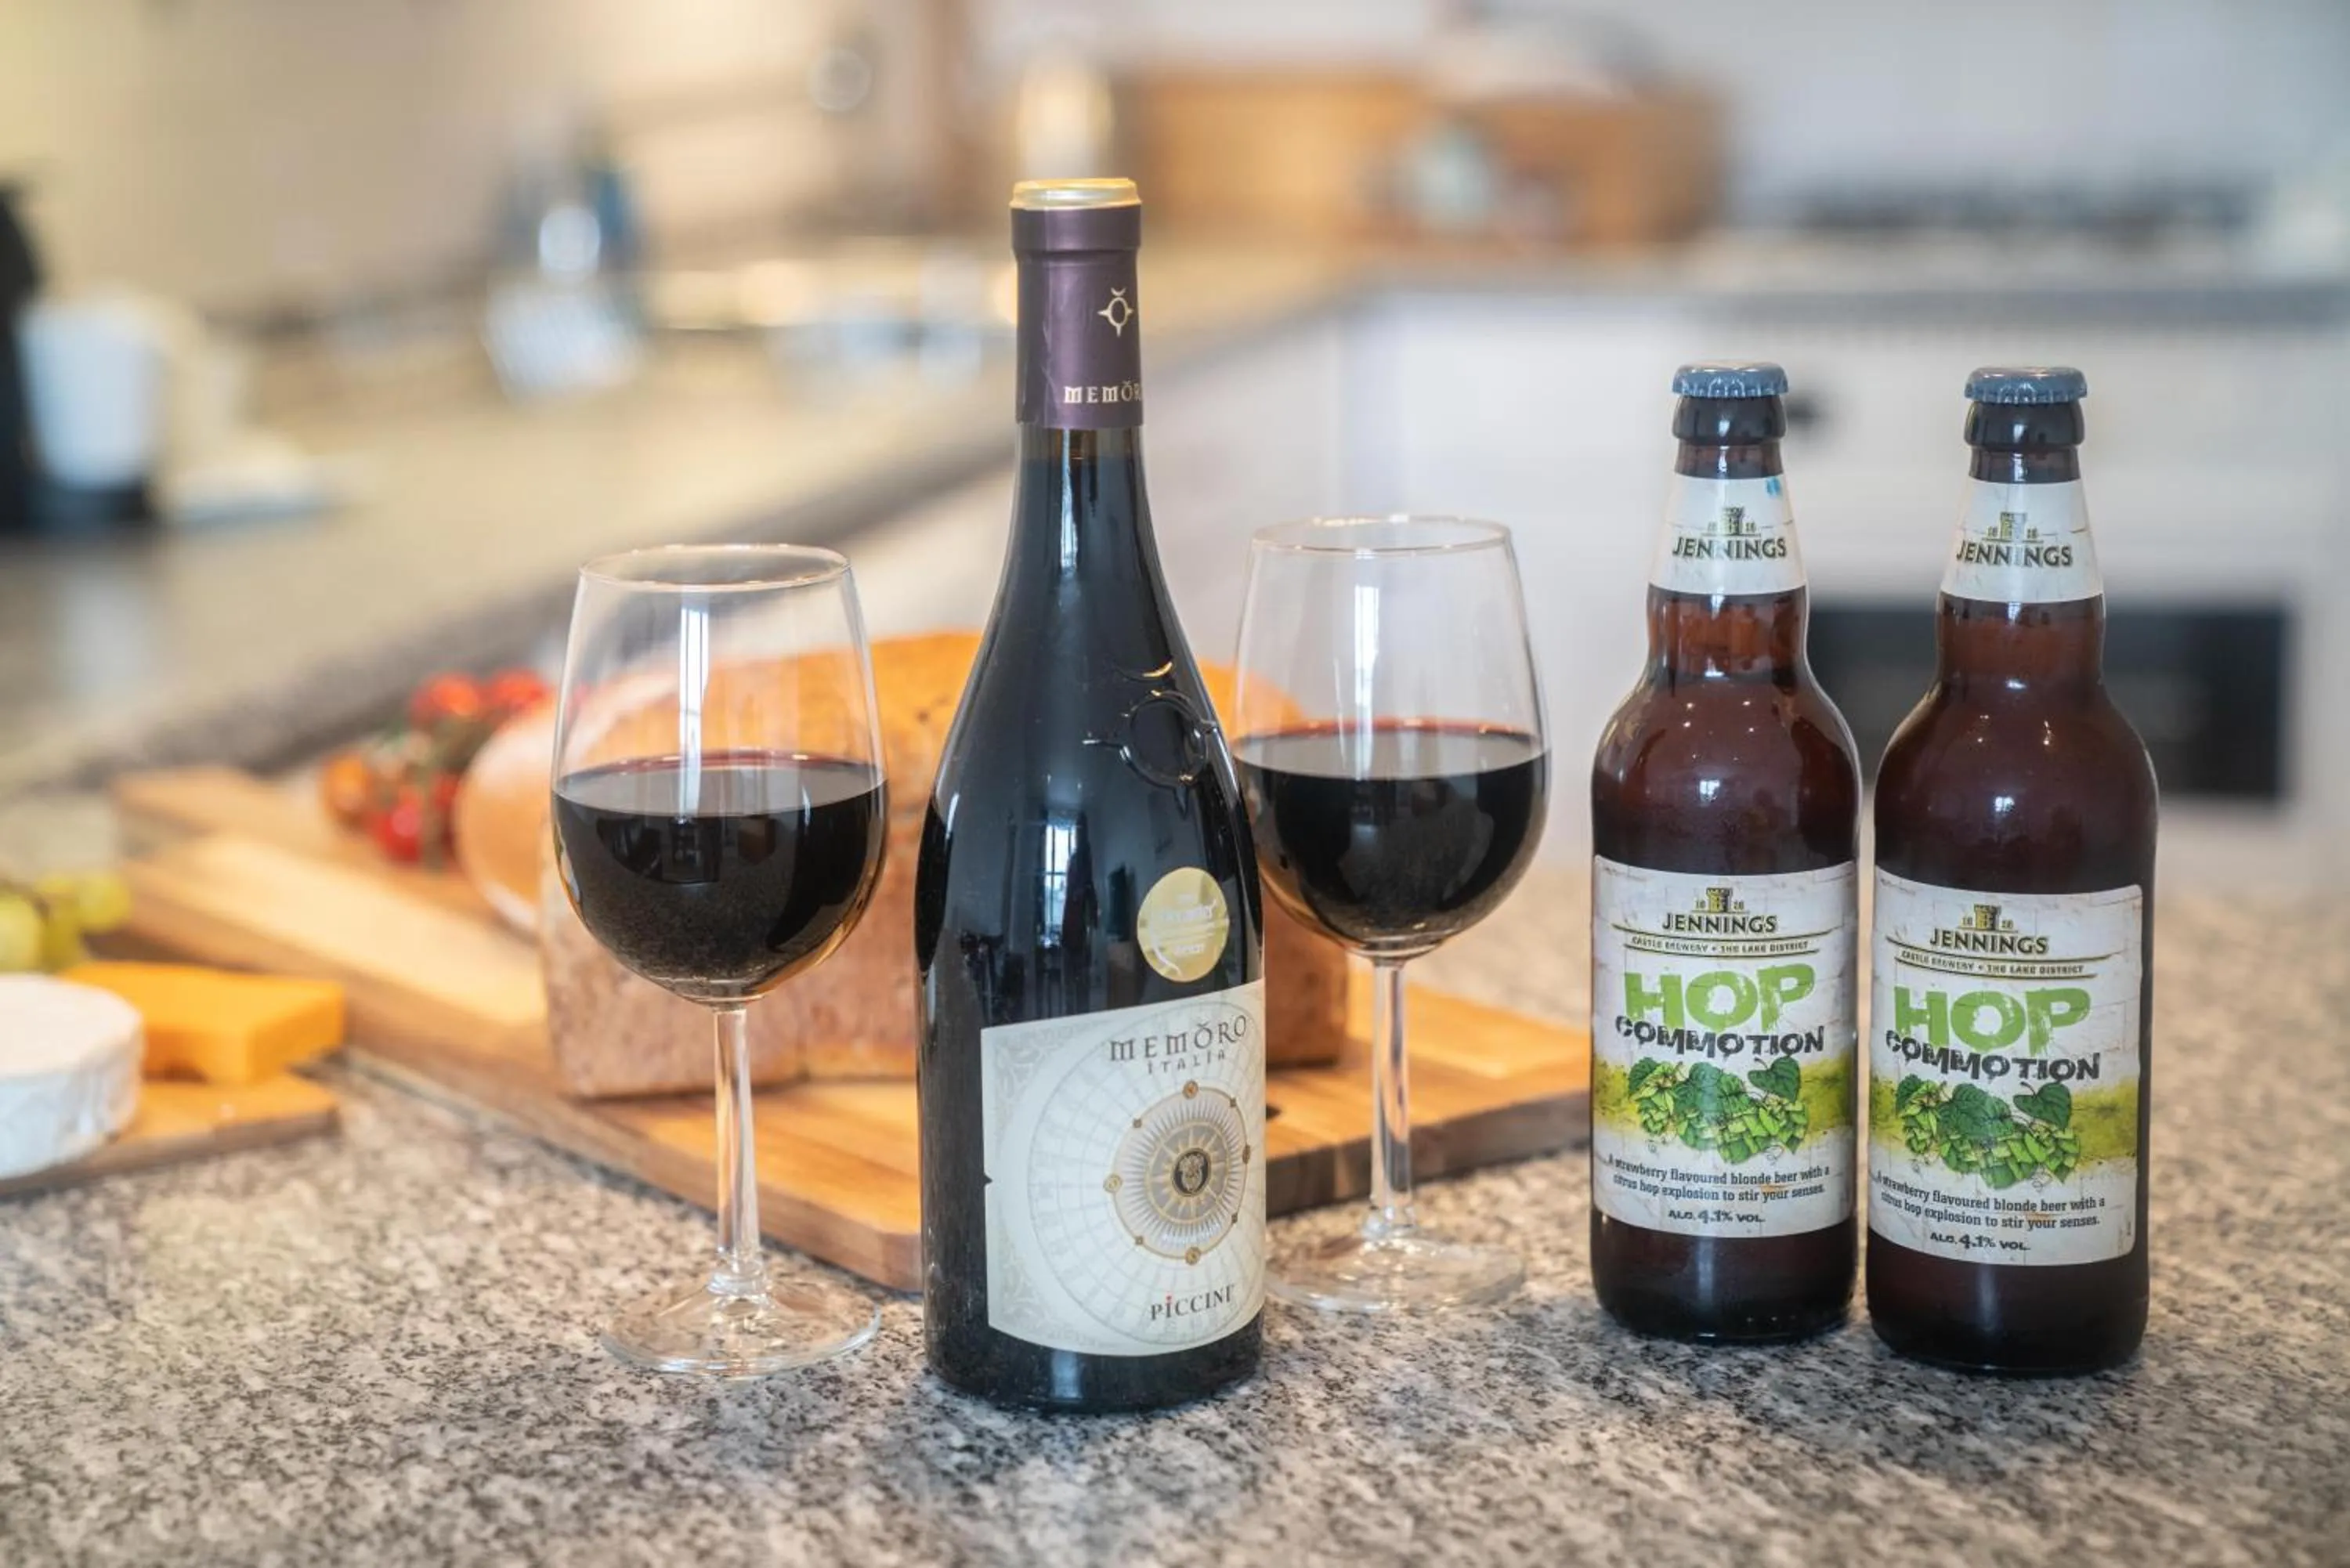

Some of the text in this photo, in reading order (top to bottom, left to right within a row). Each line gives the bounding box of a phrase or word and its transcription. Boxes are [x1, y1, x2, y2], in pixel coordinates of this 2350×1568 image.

[1672, 537, 1788, 560] JENNINGS
[1956, 540, 2073, 567] JENNINGS
[1662, 912, 1777, 934] JENNINGS
[1665, 941, 1708, 952] BREWERY
[1770, 941, 1808, 952] DISTRICT
[1929, 927, 2049, 955] JENNINGS
[1931, 957, 1974, 970] BREWERY
[1987, 964, 2005, 973] THE
[2039, 965, 2084, 974] DISTRICT
[1625, 963, 1816, 1034] HOP
[1894, 986, 2092, 1057] HOP
[1615, 1015, 1824, 1059] COMMOTION
[1148, 1050, 1225, 1075] ITALIA
[1886, 1029, 2100, 1081] COMMOTION
[1614, 1158, 1667, 1182] strawberry
[1670, 1168, 1726, 1184] flavoured
[1730, 1172, 1772, 1185] blonde
[1774, 1171, 1798, 1183] beer
[1799, 1165, 1823, 1180] with
[1640, 1180, 1660, 1197] hop
[1661, 1186, 1719, 1201] explosion
[1723, 1189, 1735, 1201] to
[1738, 1189, 1759, 1201] stir
[1762, 1190, 1788, 1204] your
[1883, 1176, 1929, 1201] strawberry
[1932, 1190, 1990, 1210] flavoured
[1994, 1198, 2037, 1212] blonde
[2041, 1199, 2067, 1212] beer
[2070, 1196, 2097, 1211] with
[2099, 1198, 2106, 1207] a
[1697, 1209, 1733, 1223] 4.1%
[1904, 1199, 1922, 1216] hop
[1925, 1208, 1982, 1226] explosion
[1985, 1215, 1998, 1227] to
[2001, 1216, 2024, 1229] stir
[2027, 1218, 2057, 1232] your
[2059, 1215, 2100, 1228] senses.
[1959, 1234, 1997, 1249] 4.1%
